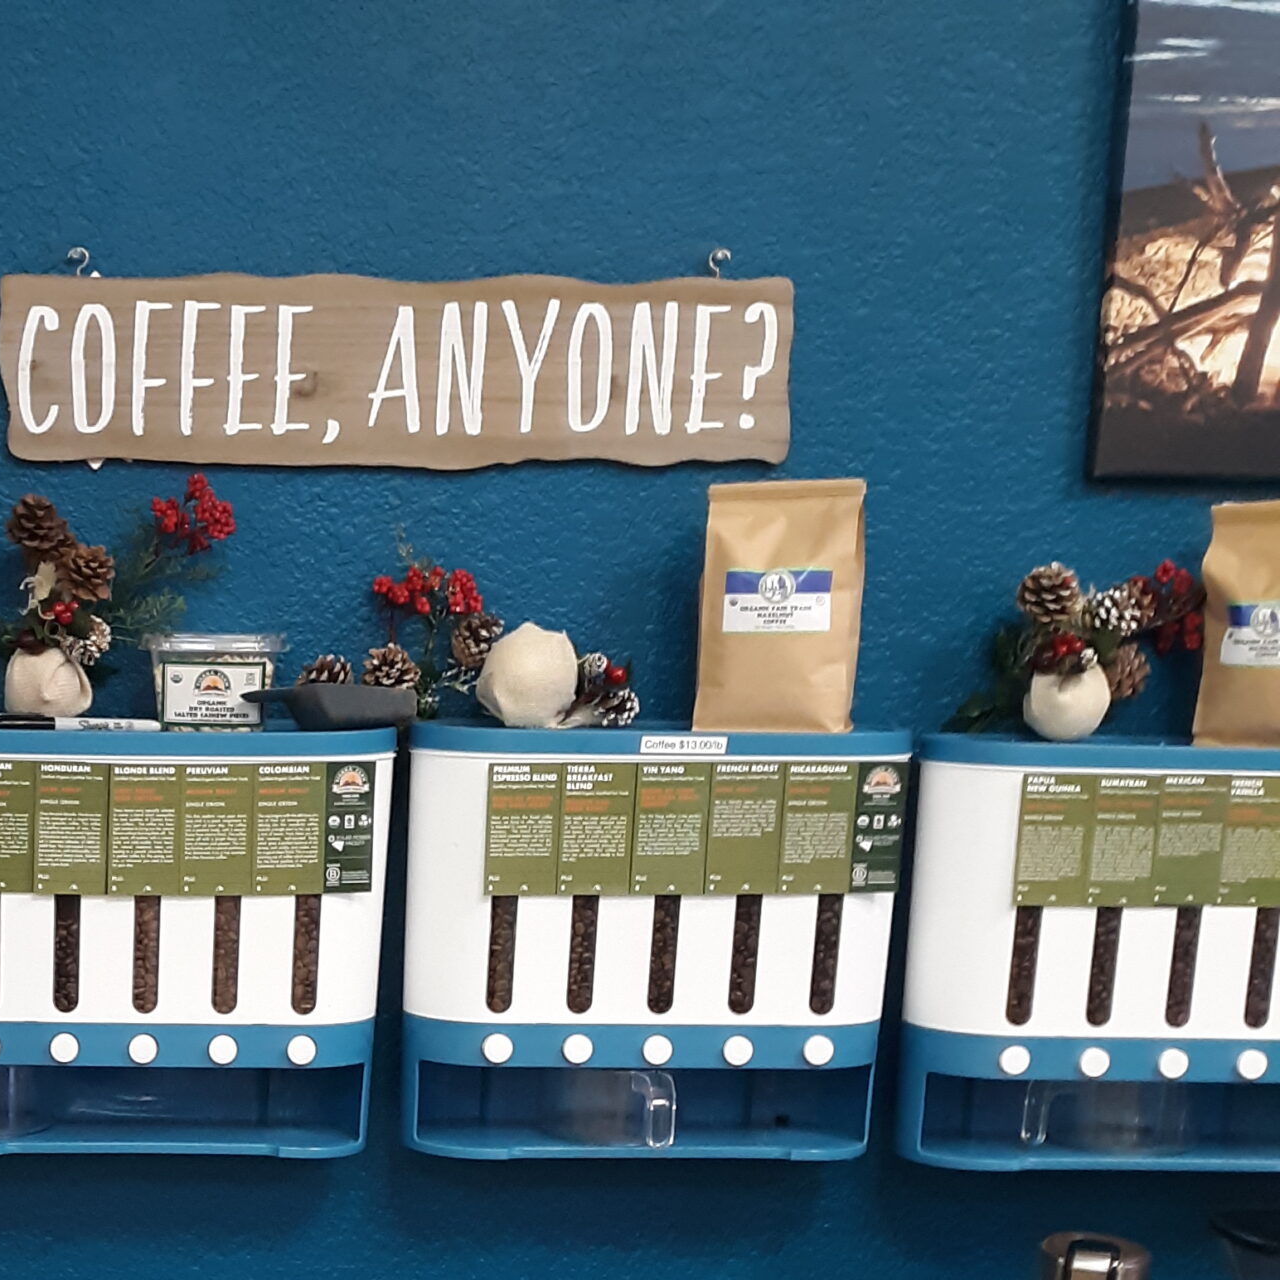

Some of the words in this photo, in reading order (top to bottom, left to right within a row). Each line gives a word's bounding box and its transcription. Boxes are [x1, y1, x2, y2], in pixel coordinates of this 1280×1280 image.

[17, 298, 341, 444] COFFEE,
[368, 298, 778, 435] ANYONE?
[644, 739, 676, 750] Coffee
[679, 739, 723, 750] $13.00/lb
[40, 764, 91, 773] HONDURAN
[114, 767, 147, 775] BLONDE
[149, 767, 176, 775] BLEND
[258, 765, 310, 774] COLOMBIAN
[493, 765, 531, 773] PREMIUM
[642, 766, 658, 774] YIN
[660, 766, 685, 774] YANG
[716, 764, 750, 773] FRENCH
[751, 764, 779, 773] ROAST
[790, 765, 848, 774] NICARAGUAN
[493, 773, 531, 782] ESPRESSO
[532, 774, 557, 782] BLEND
[566, 774, 613, 782] BREAKFAST
[1027, 776, 1056, 785] PAPUA
[566, 782, 593, 790] BLEND
[1027, 784, 1046, 793] NEW
[1048, 785, 1081, 793] GUINEA
